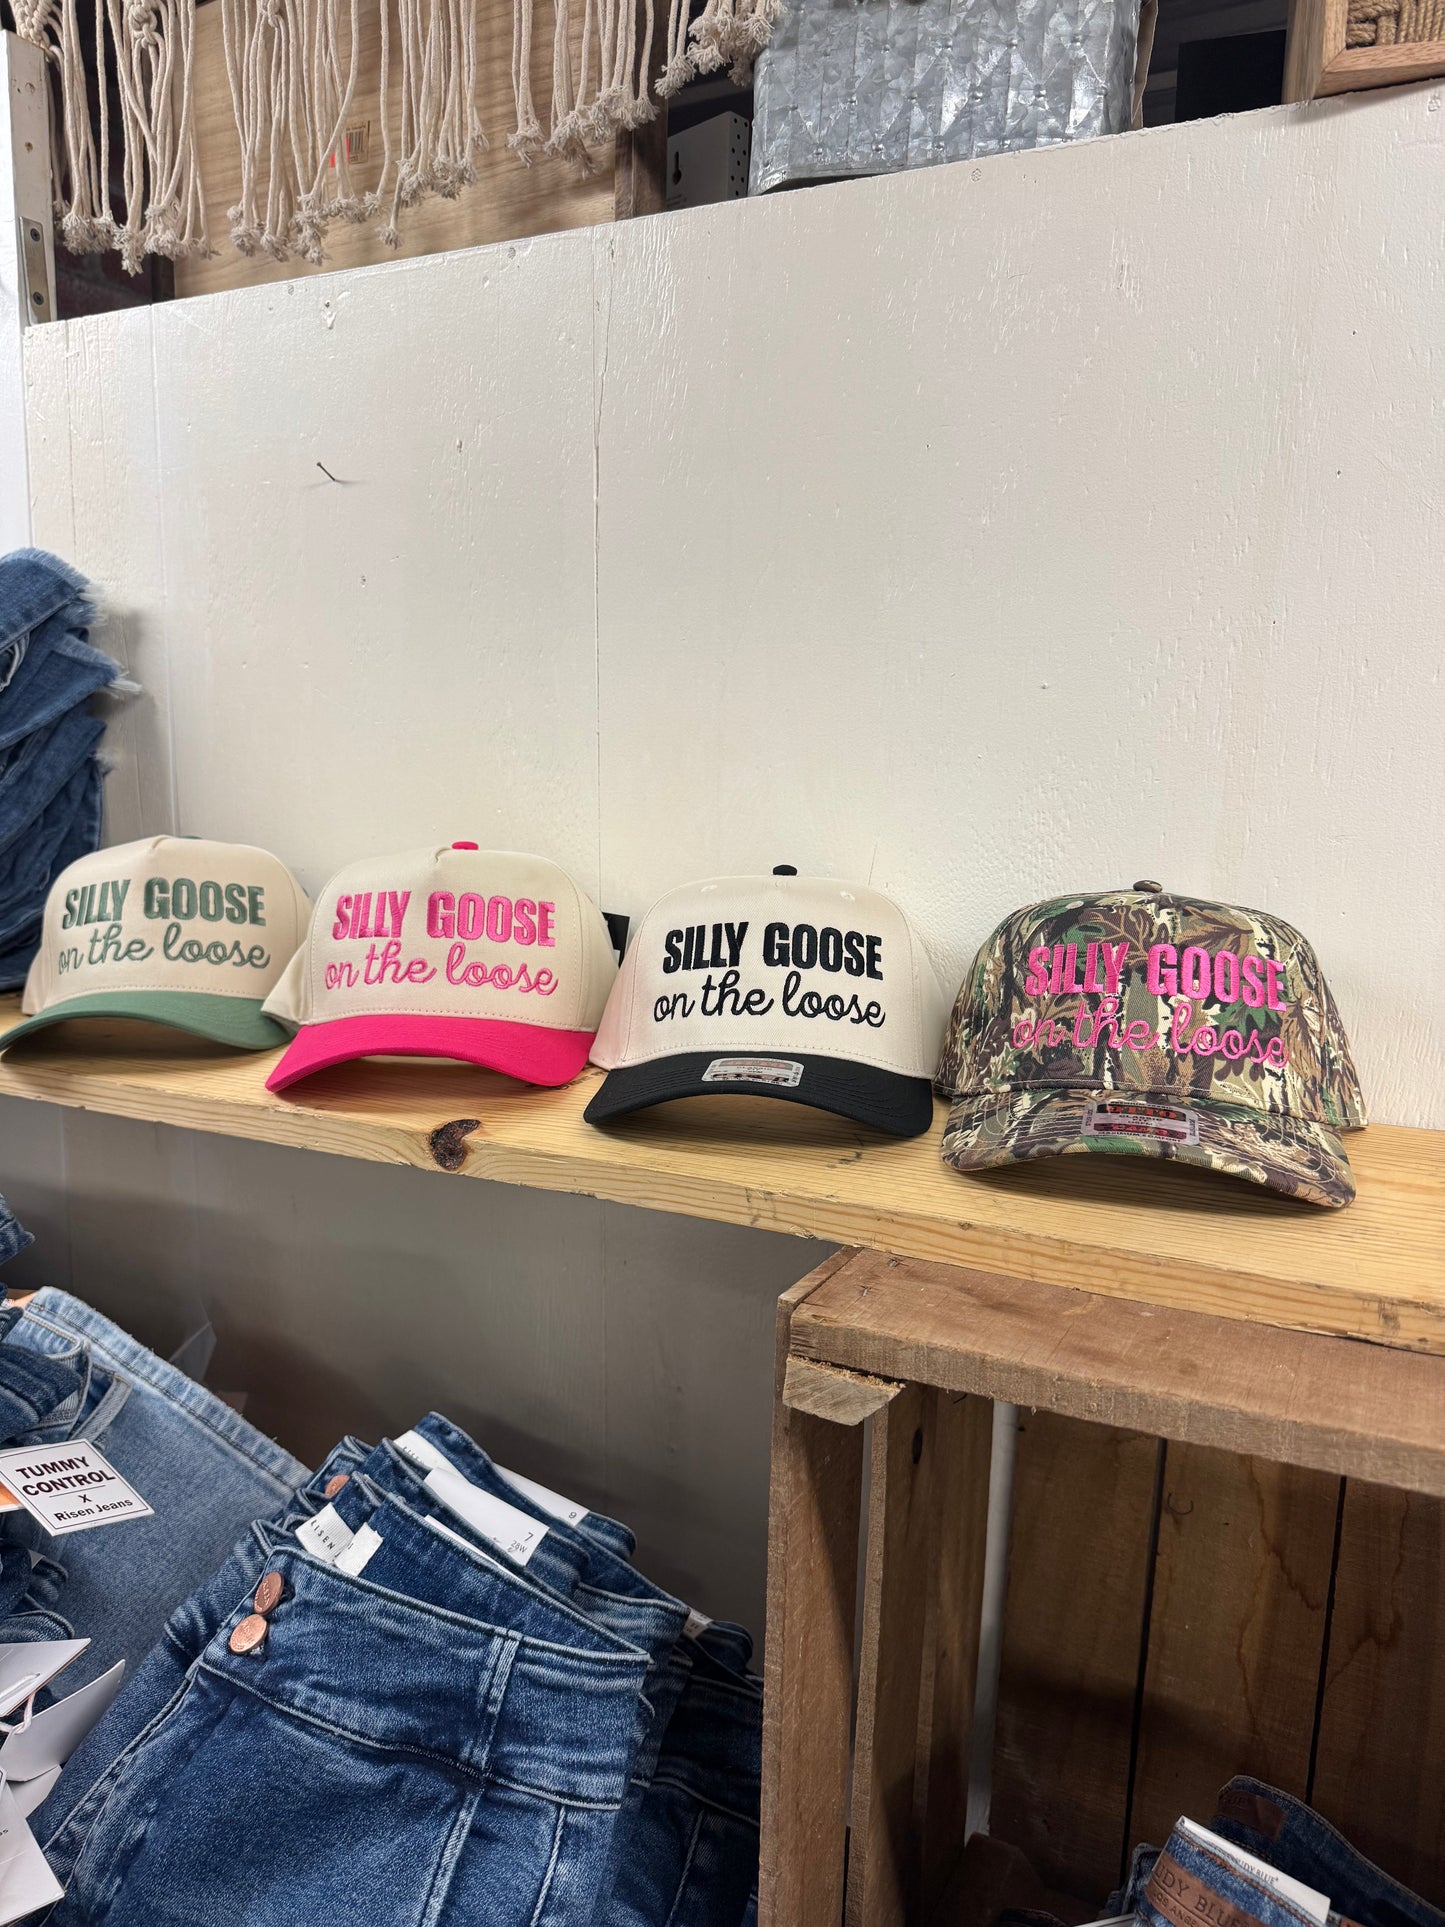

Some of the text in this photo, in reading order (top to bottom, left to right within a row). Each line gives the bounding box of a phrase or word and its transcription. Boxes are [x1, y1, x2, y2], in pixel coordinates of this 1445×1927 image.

[62, 877, 266, 930] SILLY GOOSE
[332, 890, 556, 948] SILLY GOOSE
[58, 921, 271, 976] on the loose
[324, 939, 559, 997] on the loose
[662, 921, 884, 981] SILLY GOOSE
[653, 969, 886, 1028] on the loose
[1024, 941, 1287, 1012] SILLY GOOSE
[1012, 996, 1290, 1069] on the loose
[15, 1456, 90, 1479] TUMMY
[22, 1469, 116, 1496] CONTROL
[54, 1498, 134, 1522] Risen Jeans
[568, 1511, 577, 1519] 9
[510, 1540, 528, 1553] 28W
[524, 1532, 534, 1542] 7
[1152, 1864, 1190, 1898] UDY
